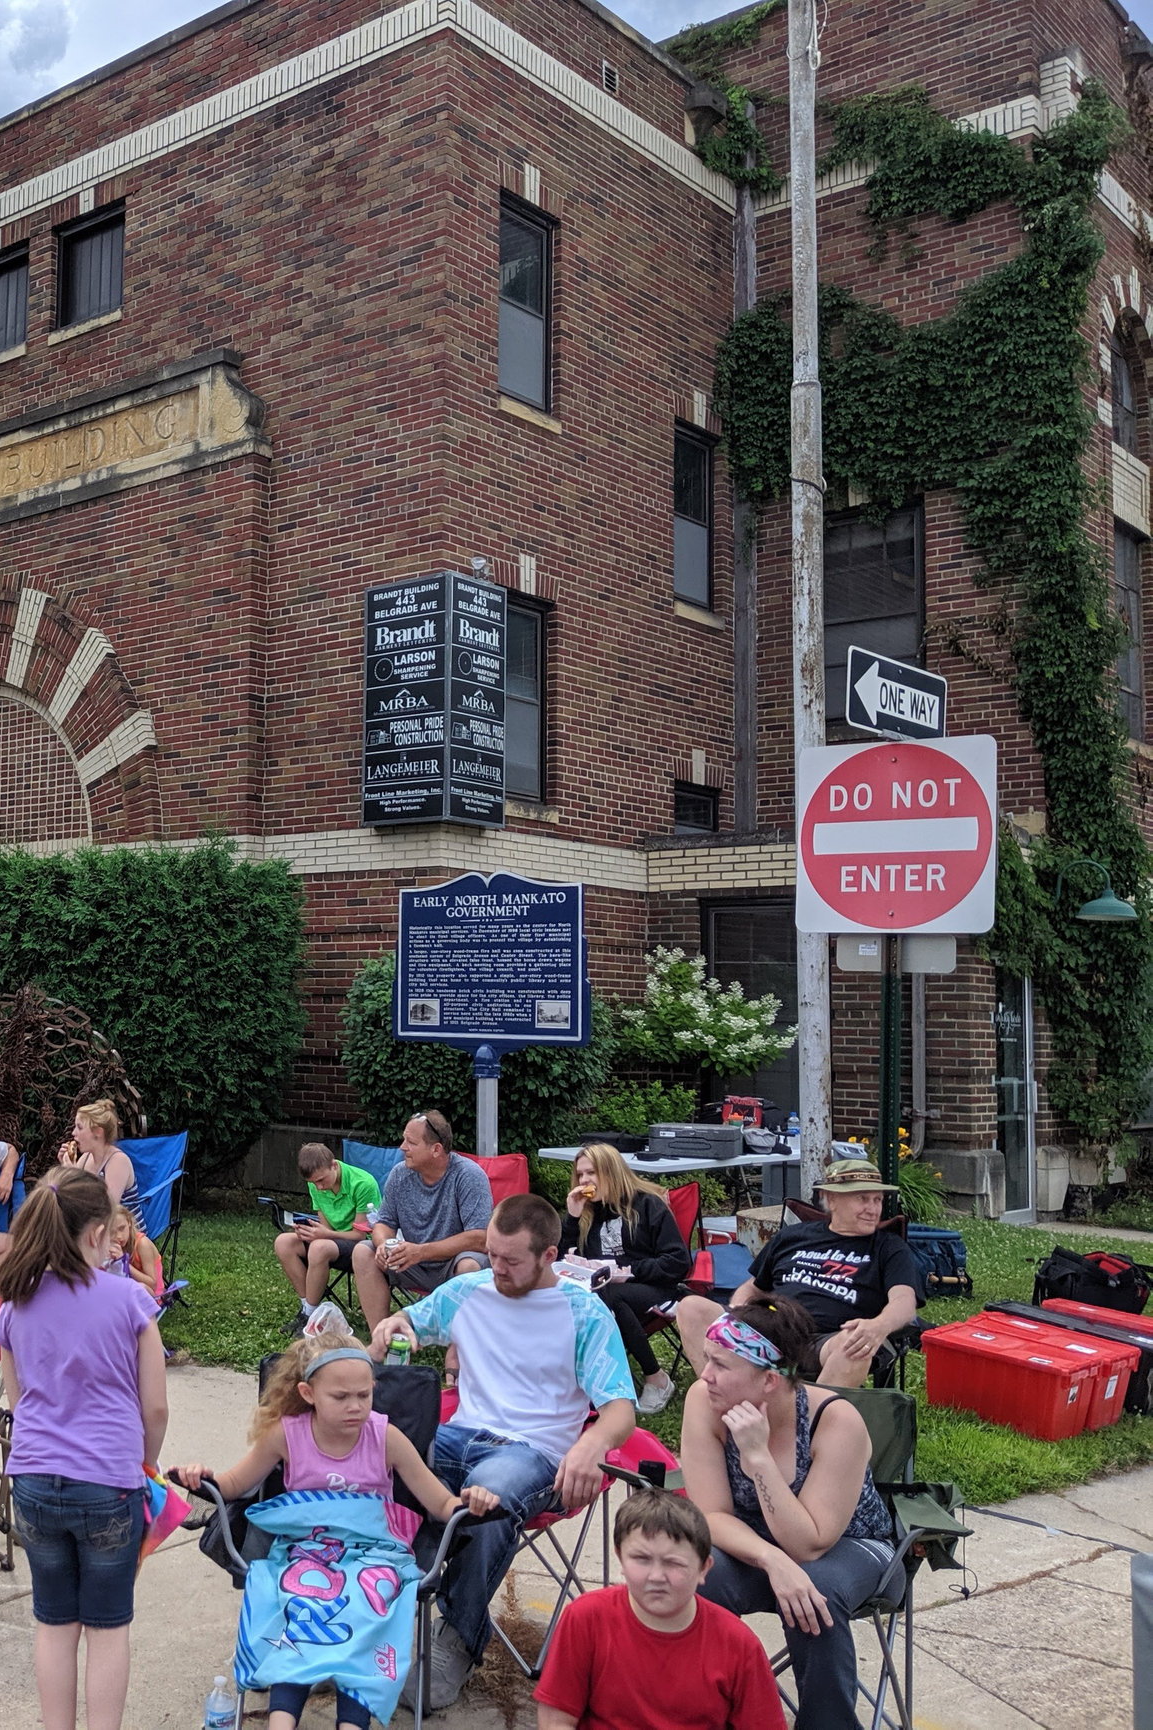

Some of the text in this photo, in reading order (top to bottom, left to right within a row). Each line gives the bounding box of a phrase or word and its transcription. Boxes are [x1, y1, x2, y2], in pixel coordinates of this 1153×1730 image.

[4, 403, 178, 491] BUILDING
[374, 583, 439, 601] BRANDT BUILDING
[396, 595, 415, 605] 443
[458, 582, 502, 602] BRANDT BUILDING
[473, 596, 487, 606] 443
[375, 601, 437, 619] BELGRADE AVE
[458, 601, 501, 620] BELGRADE AVE
[375, 619, 436, 646] Brandt
[459, 618, 500, 648] Brandt
[394, 650, 435, 665] LARSON
[473, 654, 499, 670] LARSON
[394, 664, 436, 674] SHARPENING
[401, 671, 428, 680] SERVICE
[472, 667, 500, 679] SHARPENING
[478, 675, 495, 684] SERVICE
[380, 696, 429, 712] MRBA
[462, 695, 495, 713] MRBA
[880, 682, 936, 724] ONE WAY
[390, 716, 443, 733] PERSONAL PRIDE
[470, 720, 504, 738] PERSONAL PRIDE
[394, 729, 444, 745] CONSTRUCTION
[473, 734, 503, 751] CONSTRUCTION
[367, 759, 440, 780] LANGEMEIER
[452, 759, 501, 782] LANGEMEIER
[830, 778, 962, 812] DO NOT
[840, 864, 946, 892] ENTER
[414, 892, 566, 907] EARLY NORTH MANKATO
[446, 906, 530, 918] GOVERNMENT
[791, 1249, 830, 1260] proud
[830, 1250, 845, 1261] to
[845, 1251, 861, 1263] be
[797, 1261, 821, 1269] MANKATO
[822, 1260, 859, 1276] 77
[782, 1273, 857, 1304] GRANDPA
[326, 1472, 360, 1492] Be
